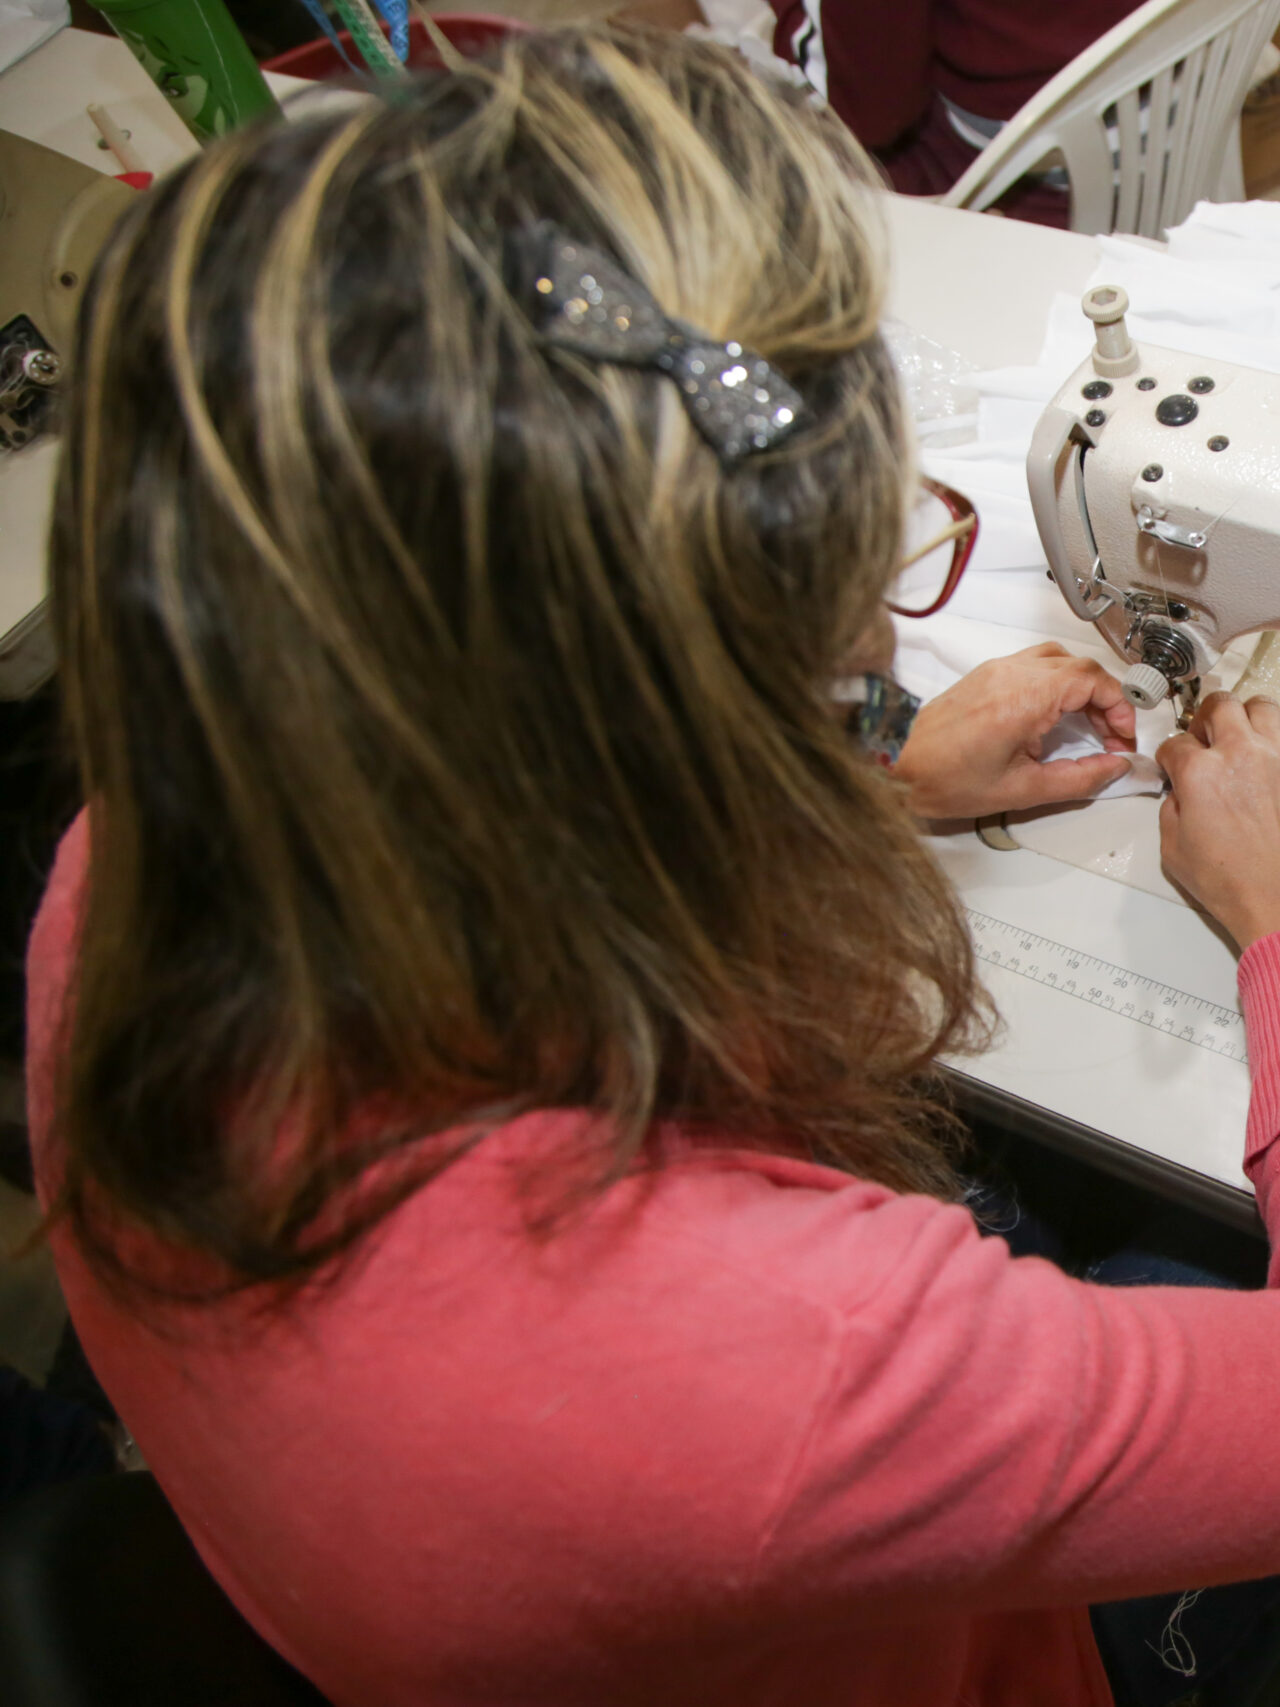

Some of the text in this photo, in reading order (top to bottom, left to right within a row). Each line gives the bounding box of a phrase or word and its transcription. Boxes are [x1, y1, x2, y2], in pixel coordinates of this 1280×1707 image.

[1019, 940, 1033, 952] 18
[1066, 959, 1080, 970] 19
[1112, 977, 1129, 989] 20
[1162, 996, 1178, 1008] 21
[1213, 1016, 1231, 1028] 22
[1087, 987, 1103, 999] 50
